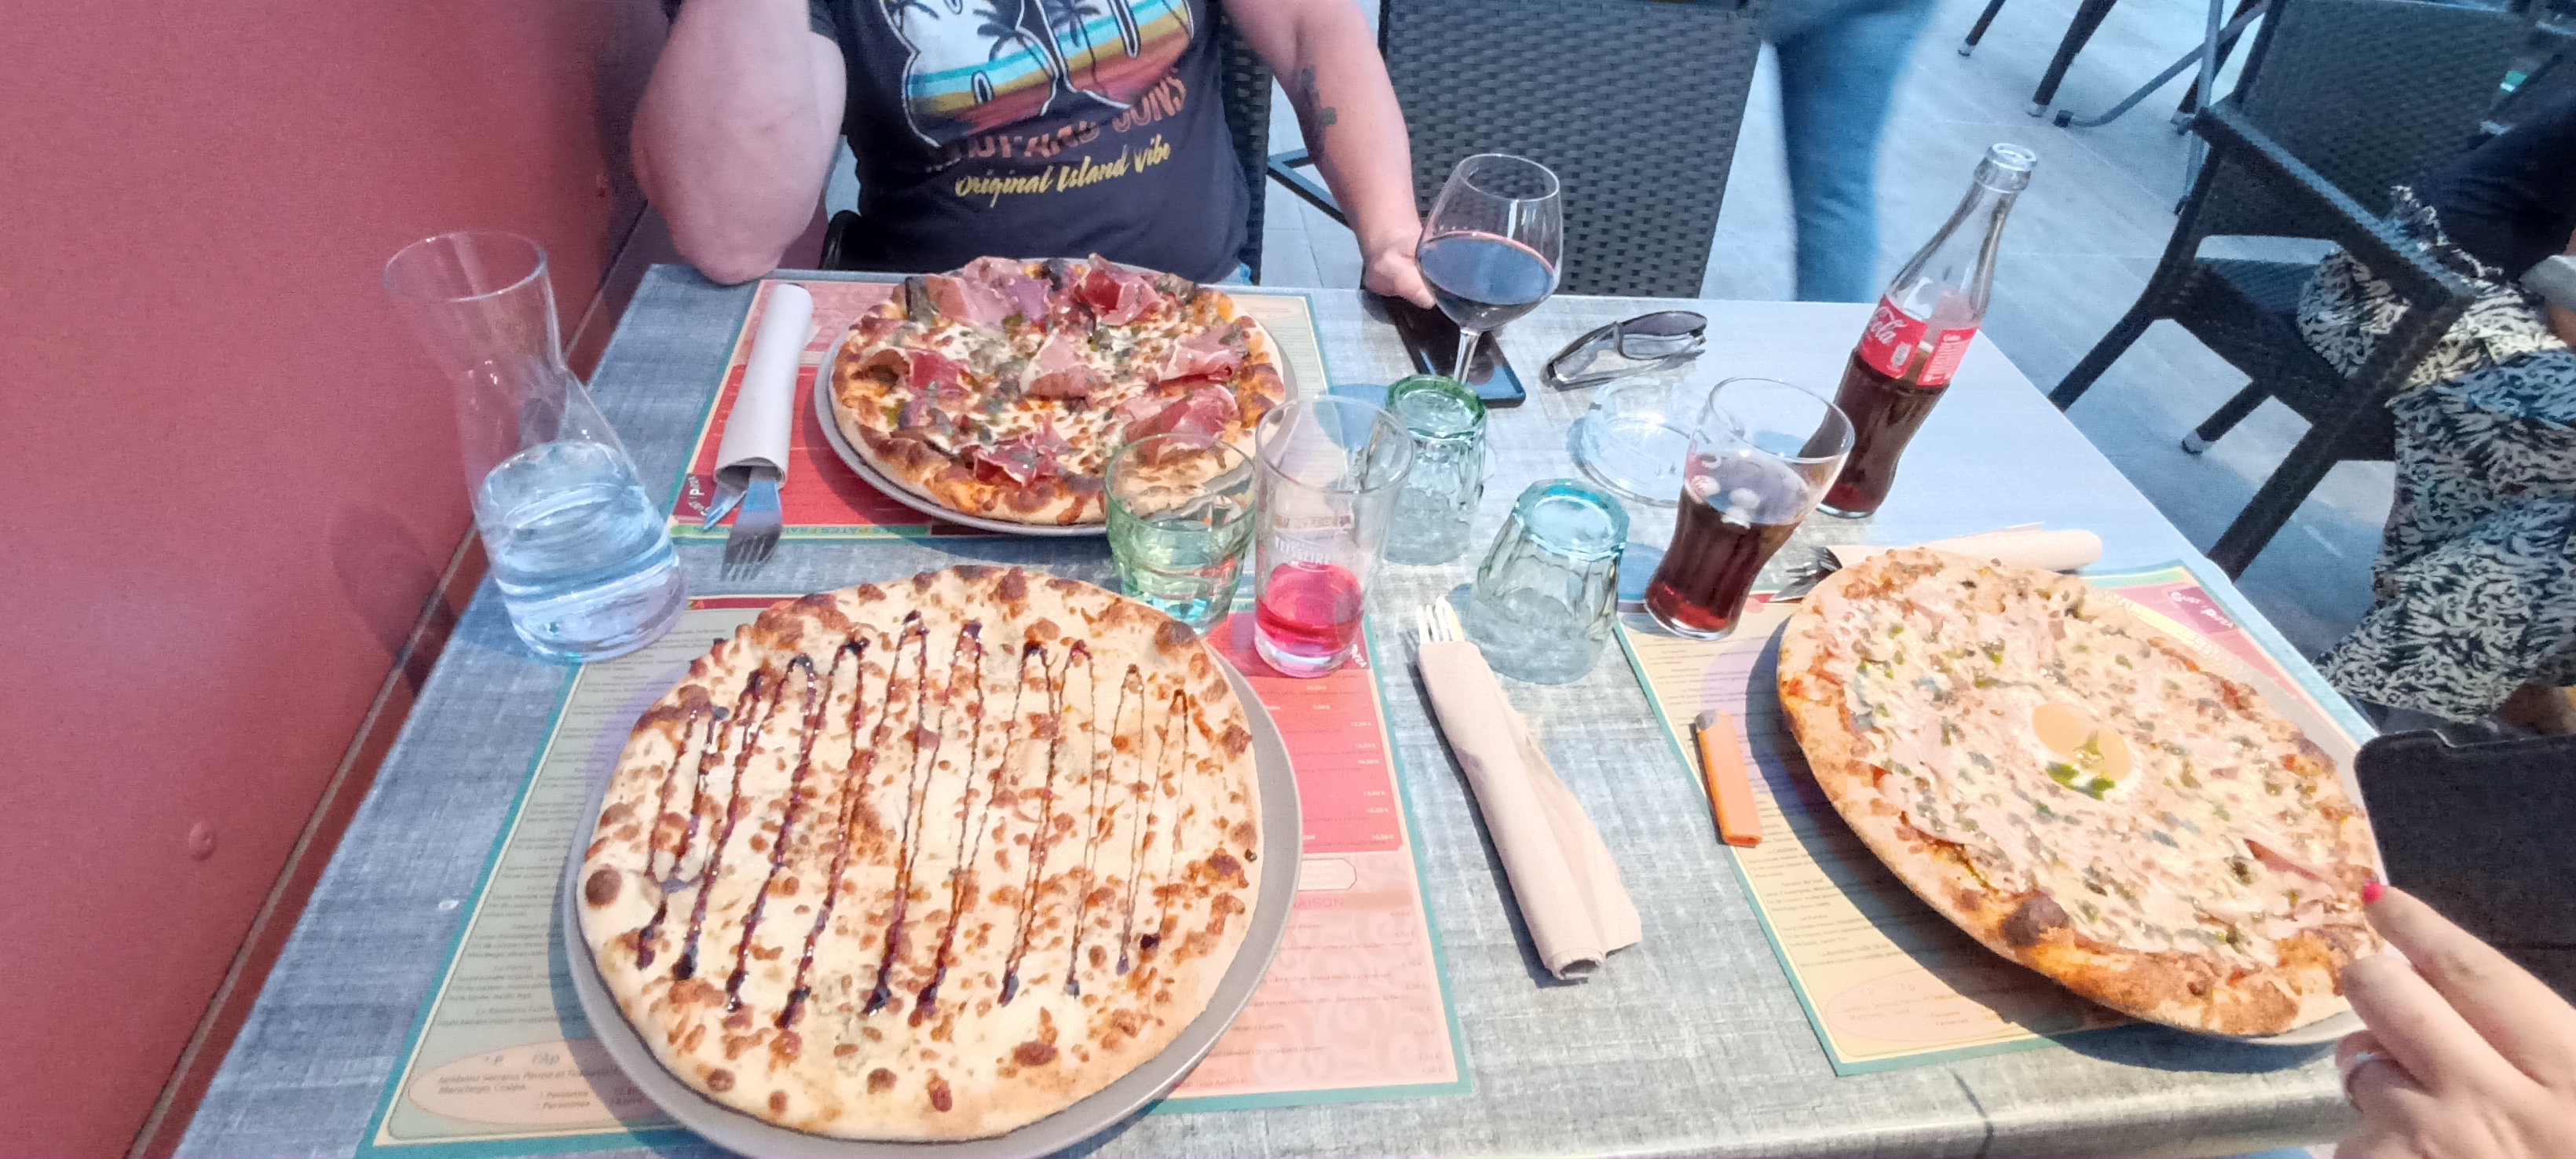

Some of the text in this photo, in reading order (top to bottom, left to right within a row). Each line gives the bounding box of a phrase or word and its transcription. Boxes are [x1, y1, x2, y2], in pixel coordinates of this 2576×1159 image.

[955, 133, 1172, 208] Original Island Vibe
